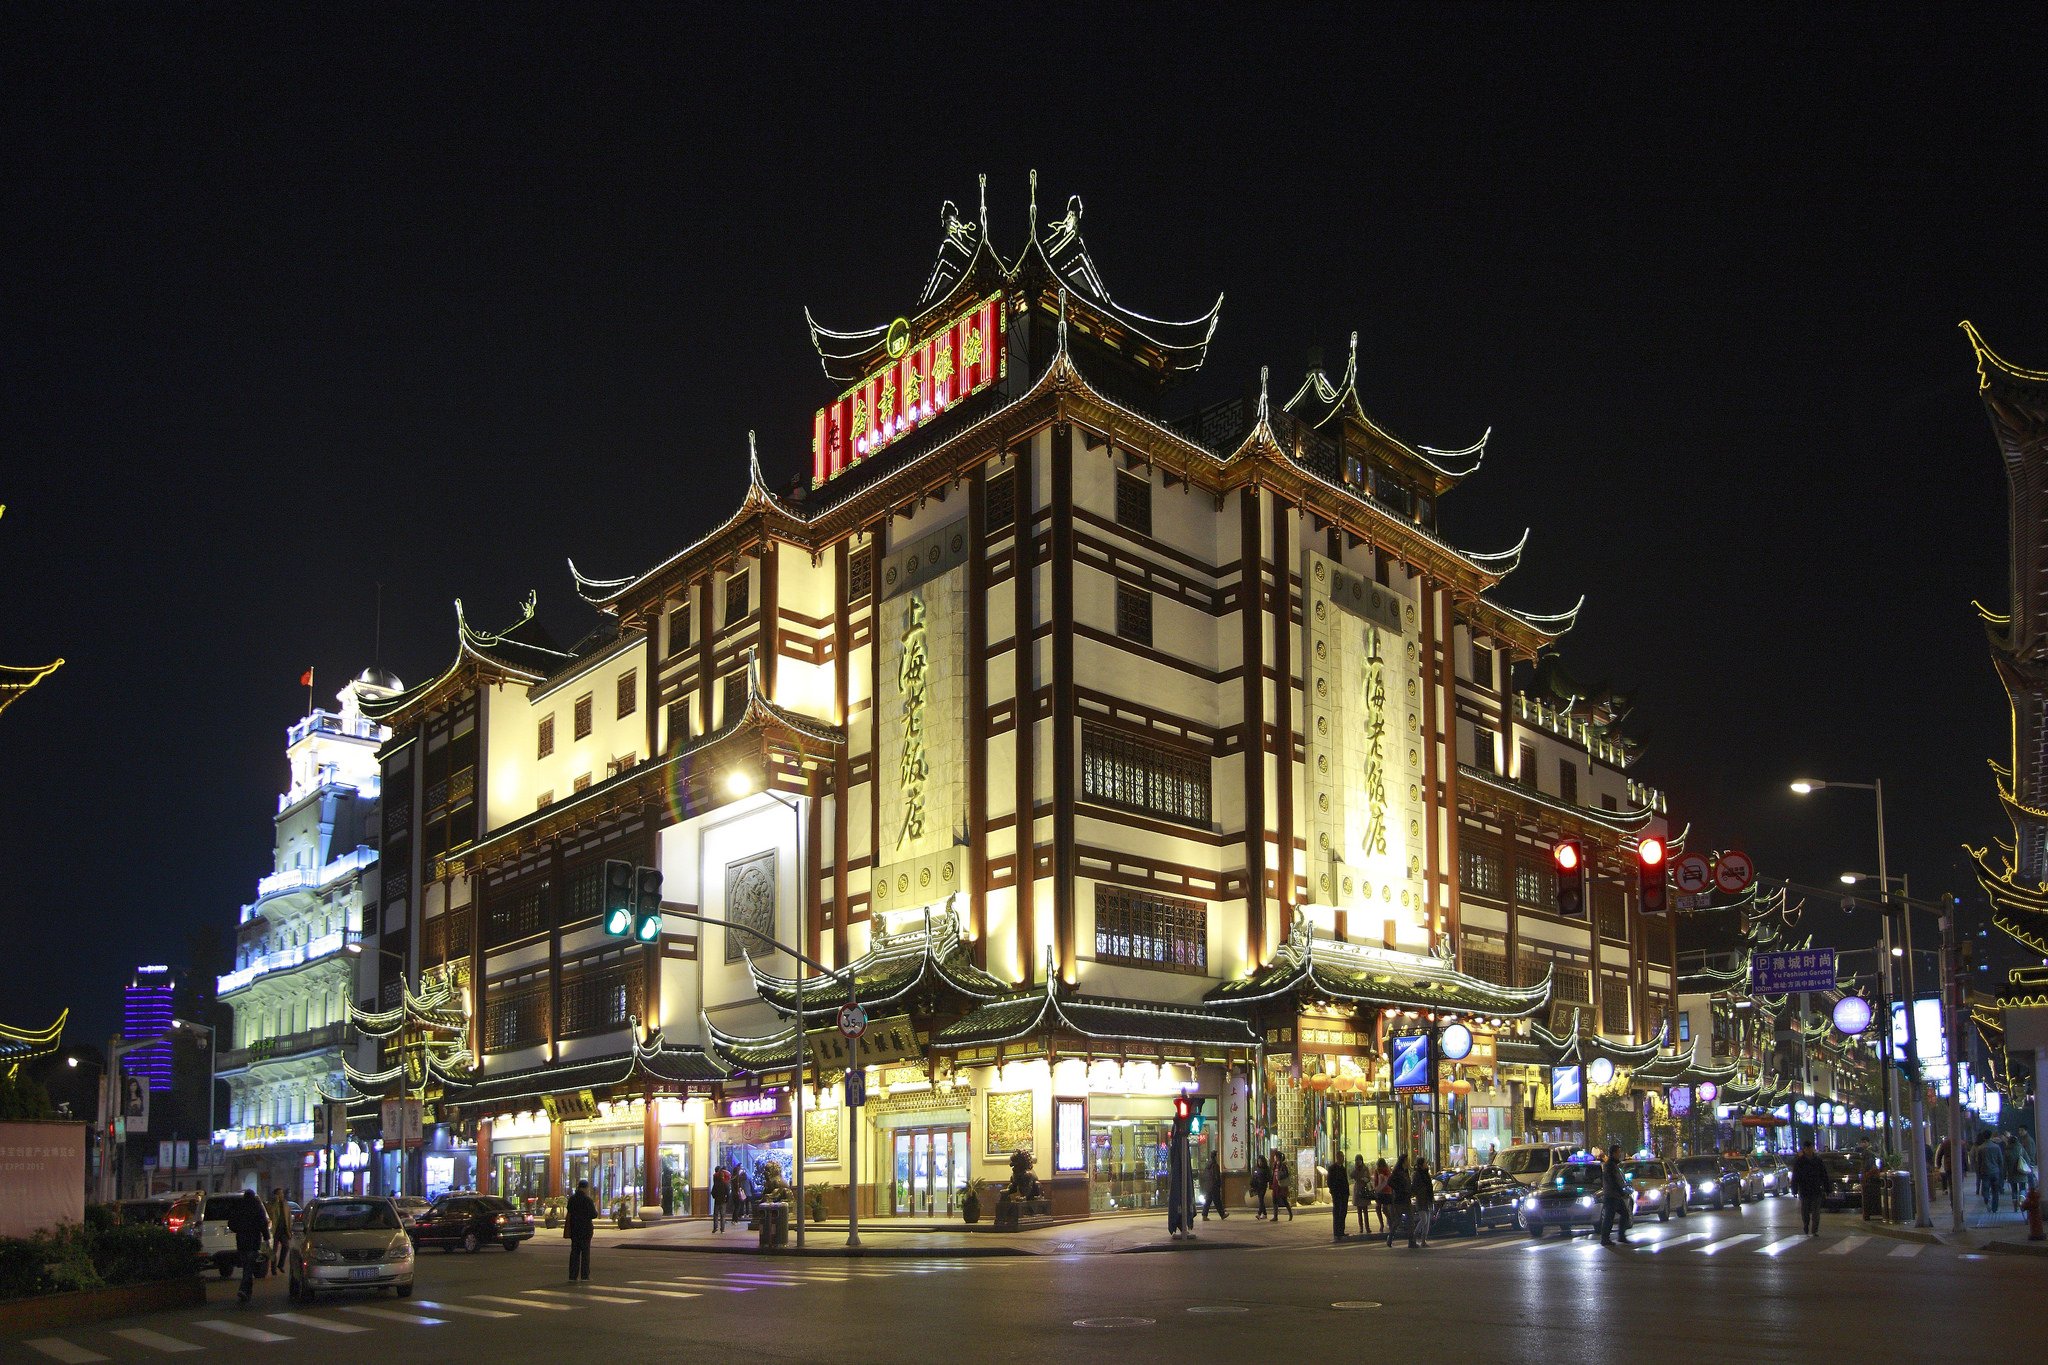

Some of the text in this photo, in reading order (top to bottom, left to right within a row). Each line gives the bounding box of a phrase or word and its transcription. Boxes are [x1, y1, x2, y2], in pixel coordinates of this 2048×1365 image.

[897, 597, 926, 852] 上海老饭店
[1772, 954, 1831, 971] 豫城时尚
[1783, 970, 1808, 978] Fashion
[1809, 968, 1832, 976] Garden
[1555, 1009, 1590, 1032] 聚堂
[1230, 1086, 1239, 1160] 上海老饭店
